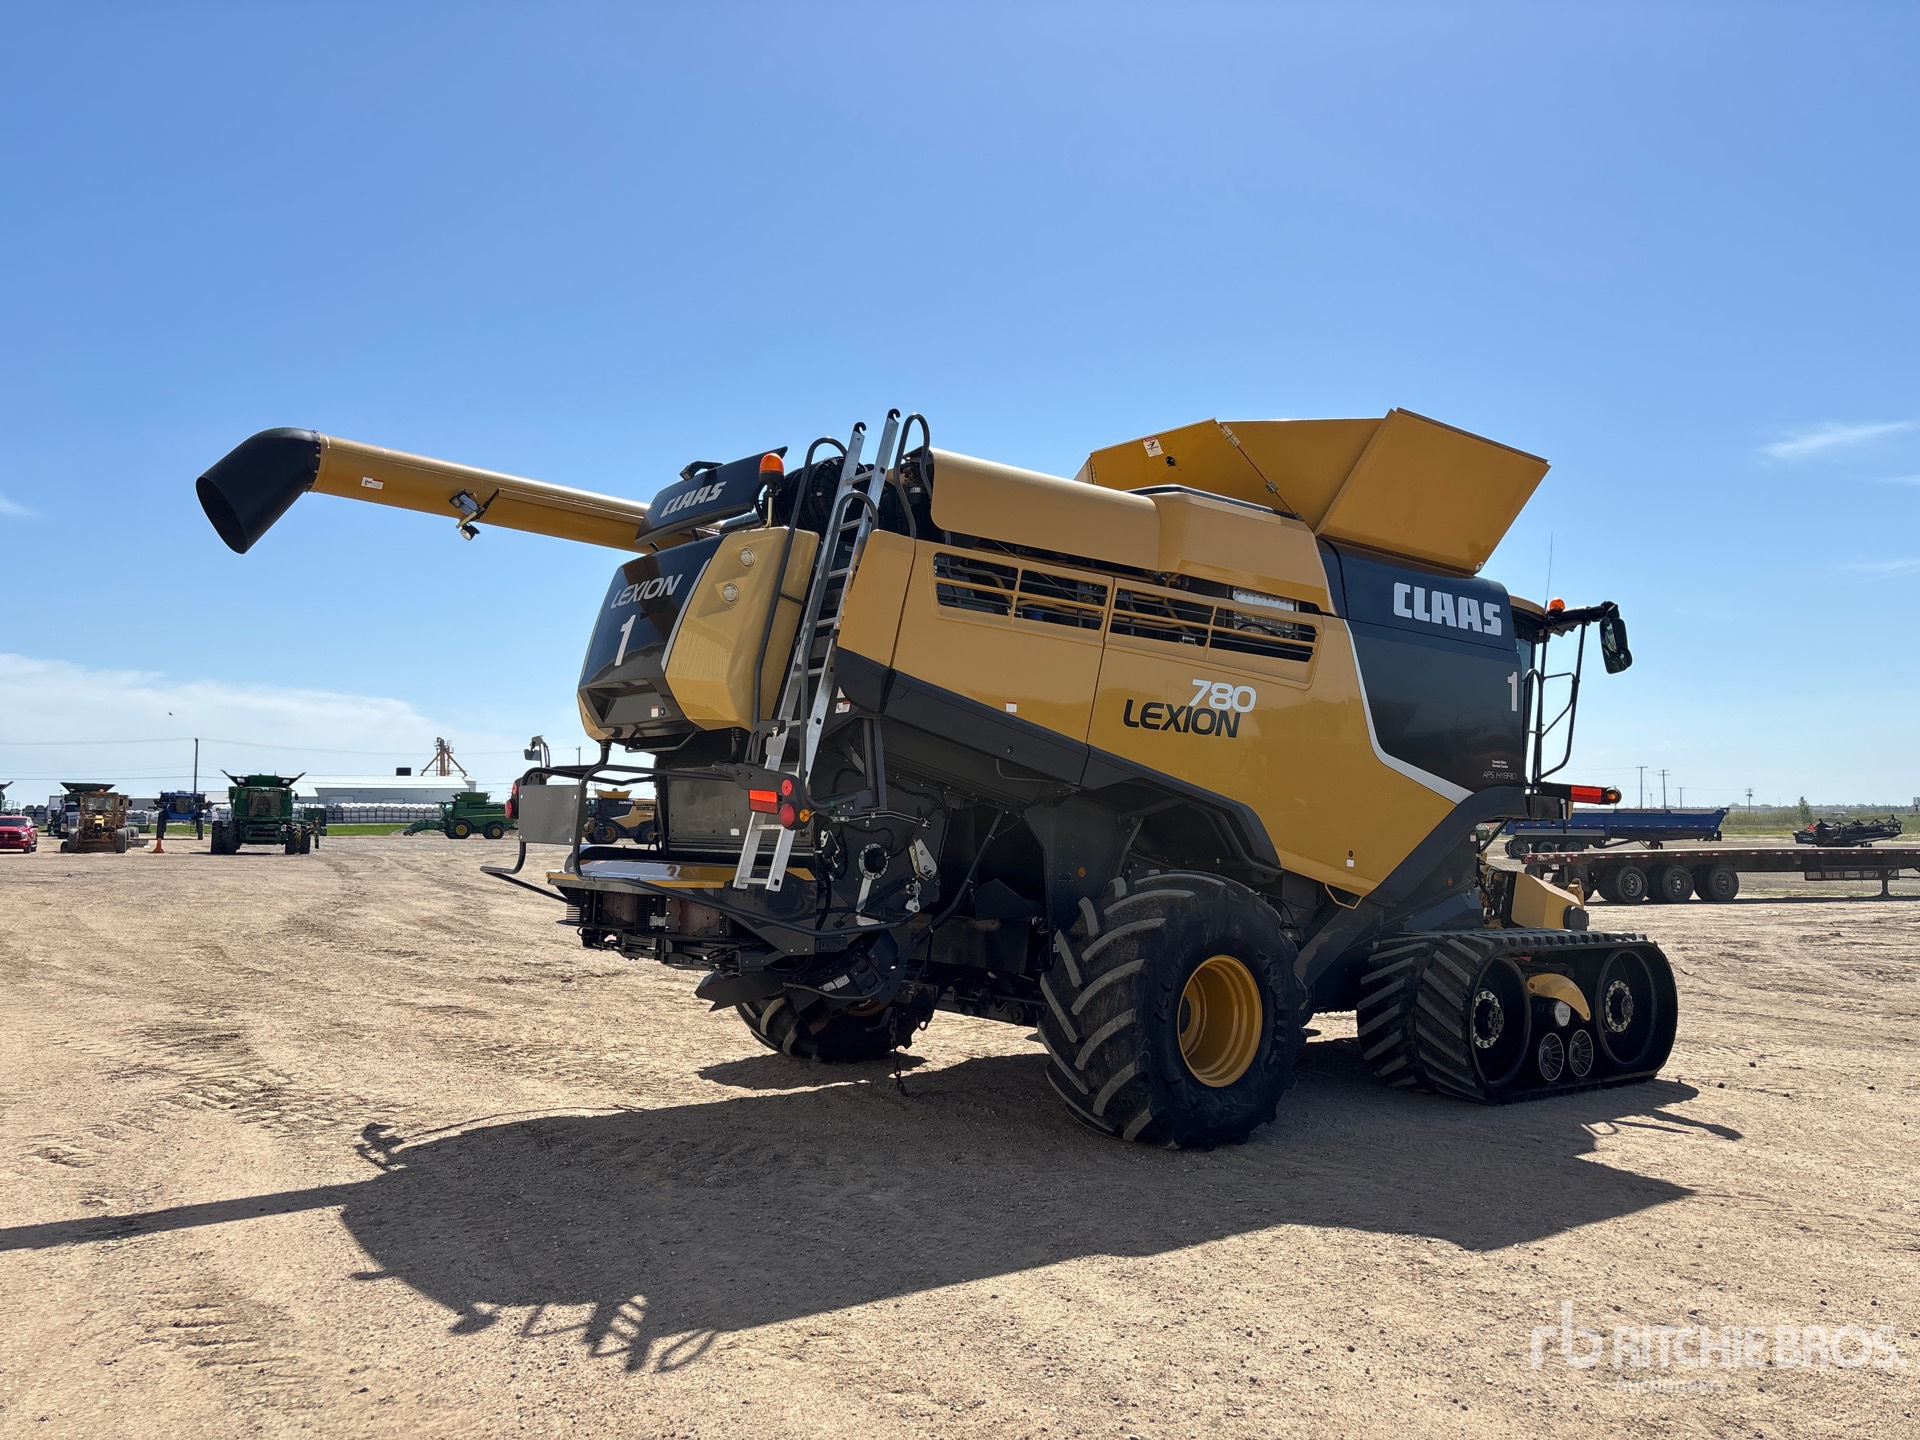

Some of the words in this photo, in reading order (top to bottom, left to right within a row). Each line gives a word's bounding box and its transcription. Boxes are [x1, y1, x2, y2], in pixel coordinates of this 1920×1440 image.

[660, 481, 727, 518] CLAAS
[610, 574, 683, 609] LEXION
[1393, 582, 1502, 636] CLAAS
[614, 614, 637, 666] 1
[1188, 678, 1257, 713] 780
[1507, 671, 1518, 712] 1
[1123, 699, 1241, 738] LEXION
[1482, 771, 1495, 779] APS
[1495, 772, 1518, 780] HYBRID
